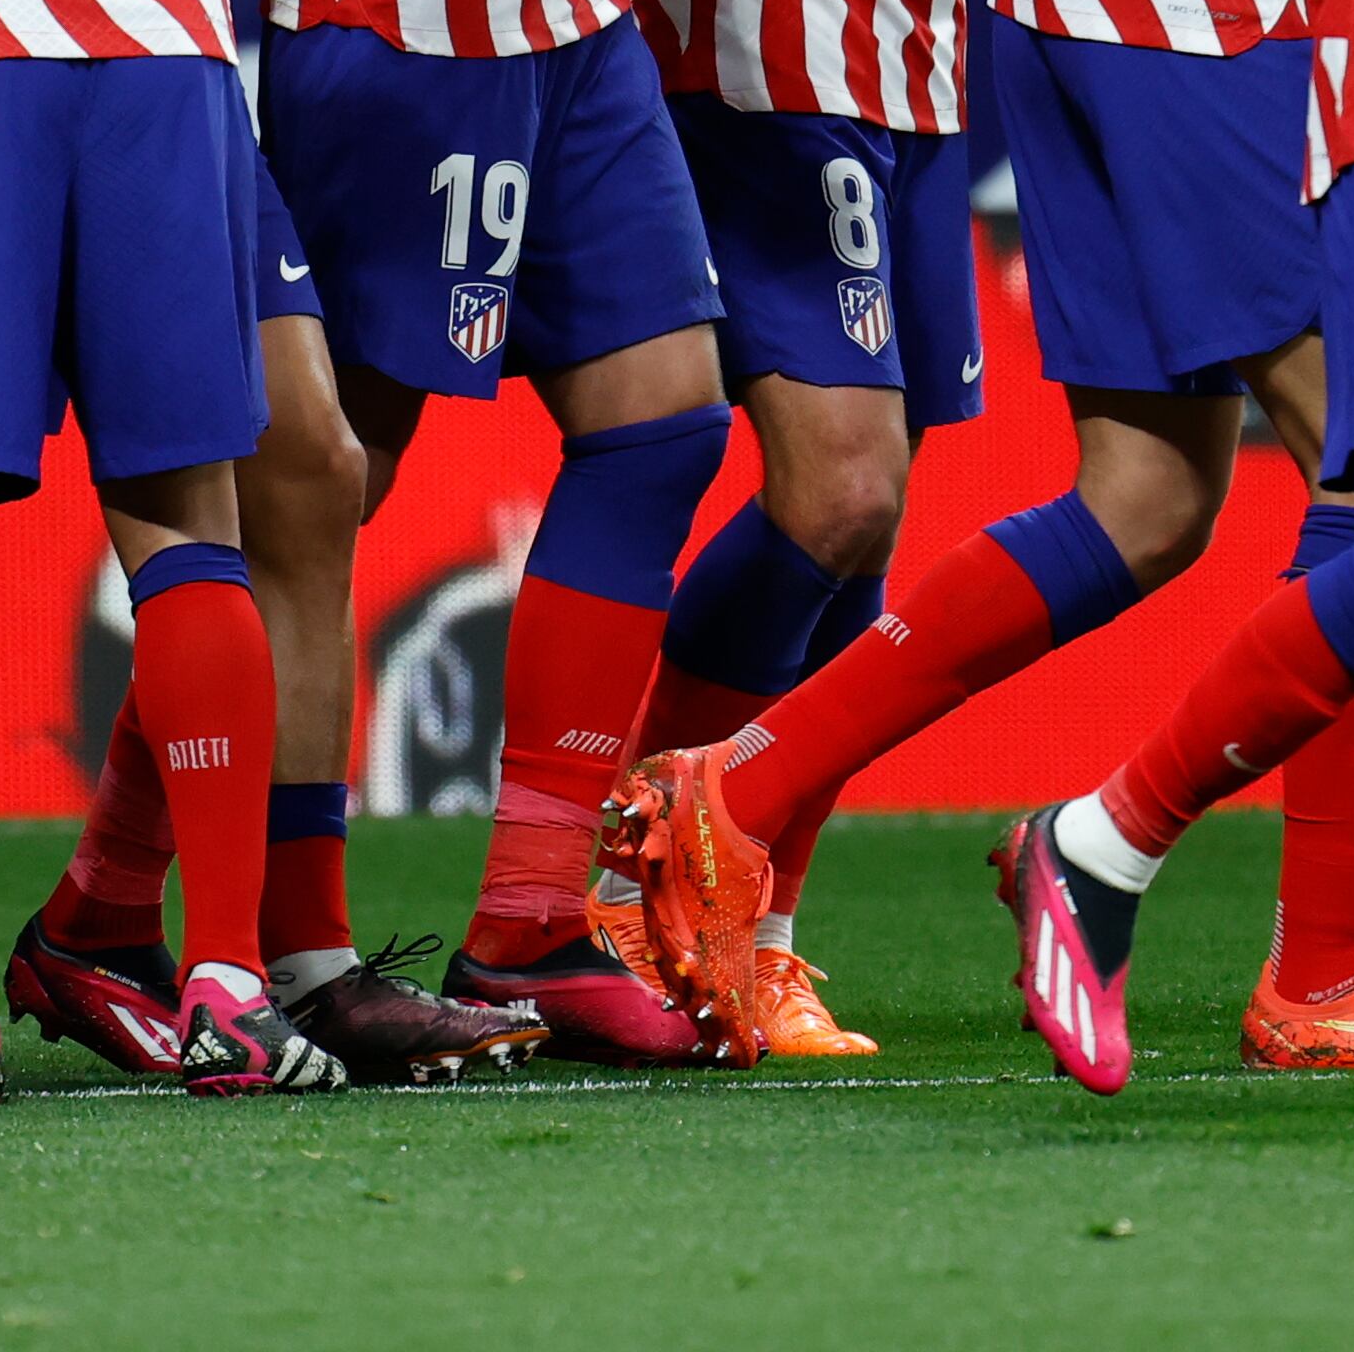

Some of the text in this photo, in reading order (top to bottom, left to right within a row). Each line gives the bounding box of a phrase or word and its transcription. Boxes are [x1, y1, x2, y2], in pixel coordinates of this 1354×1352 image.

[430, 153, 530, 276] 19
[821, 157, 880, 269] 8
[167, 736, 229, 772] ATLETI
[554, 729, 622, 756] ATLETI
